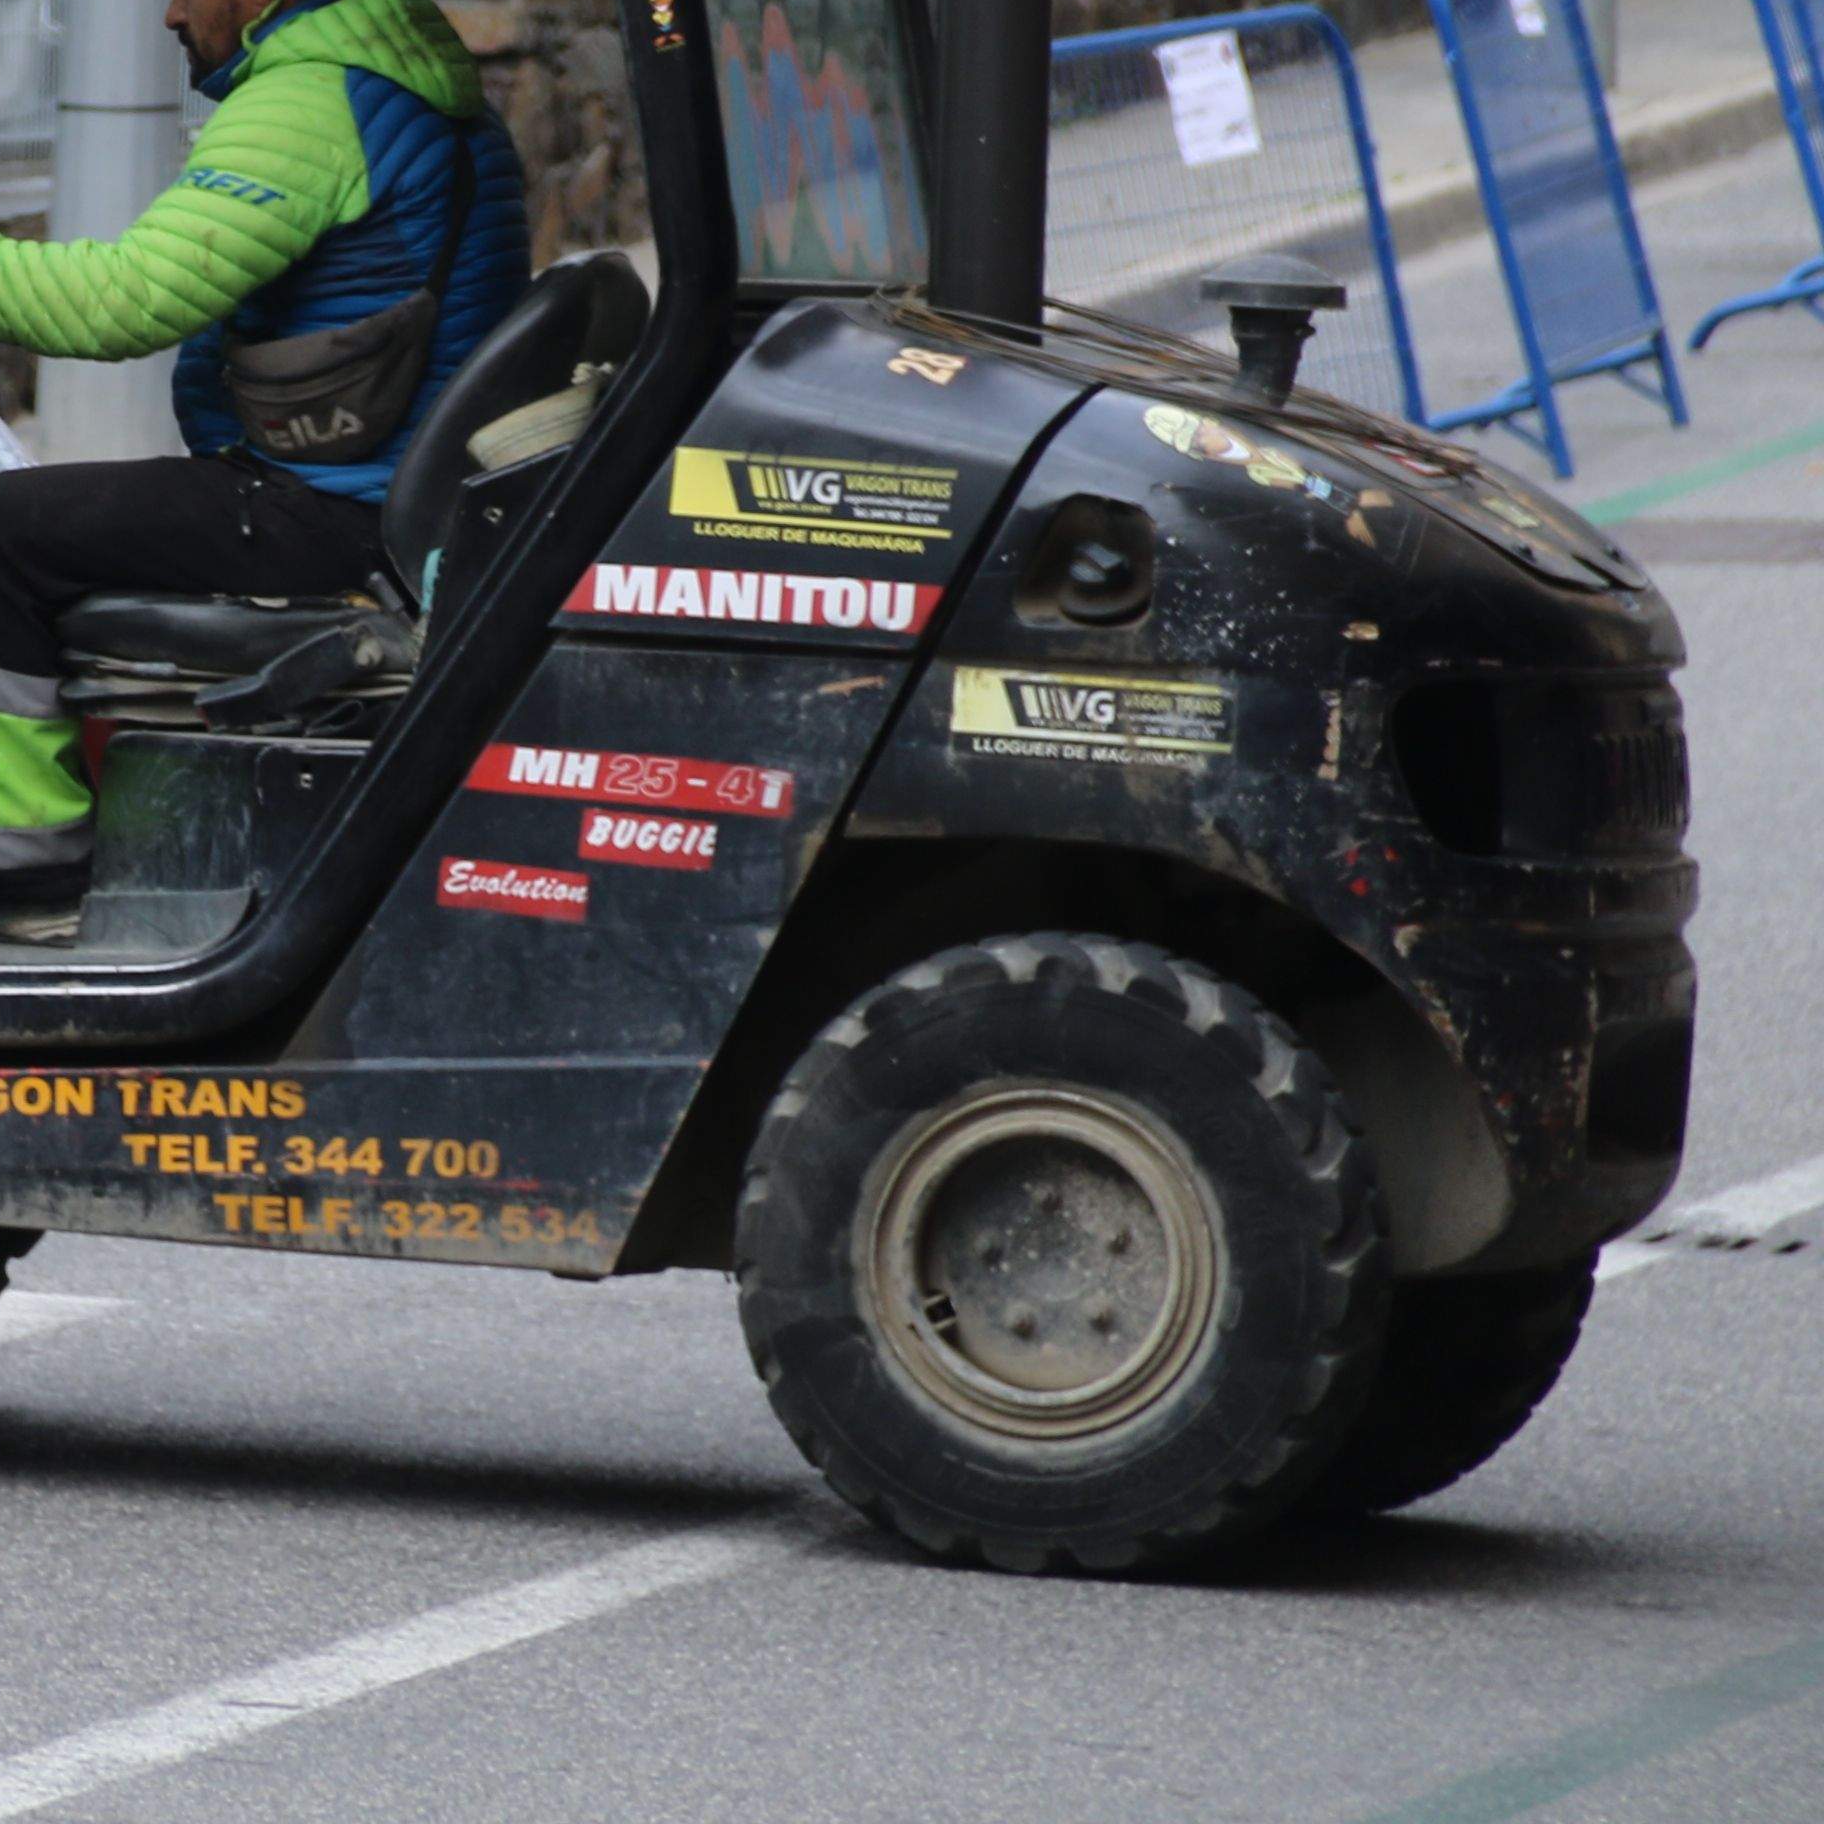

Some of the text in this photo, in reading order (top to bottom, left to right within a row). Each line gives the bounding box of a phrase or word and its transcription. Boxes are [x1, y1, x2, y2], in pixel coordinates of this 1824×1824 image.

[693, 521, 780, 542] LLOGUER
[781, 528, 808, 544] DE
[592, 564, 917, 632] MANITOU
[1061, 744, 1088, 762] DE
[585, 814, 719, 858] BUGGIE
[443, 859, 590, 904] Evolution
[117, 1078, 306, 1118] TRANS
[121, 1133, 500, 1177] TELF. 344 700
[213, 1193, 600, 1246] TELF. 322 534
